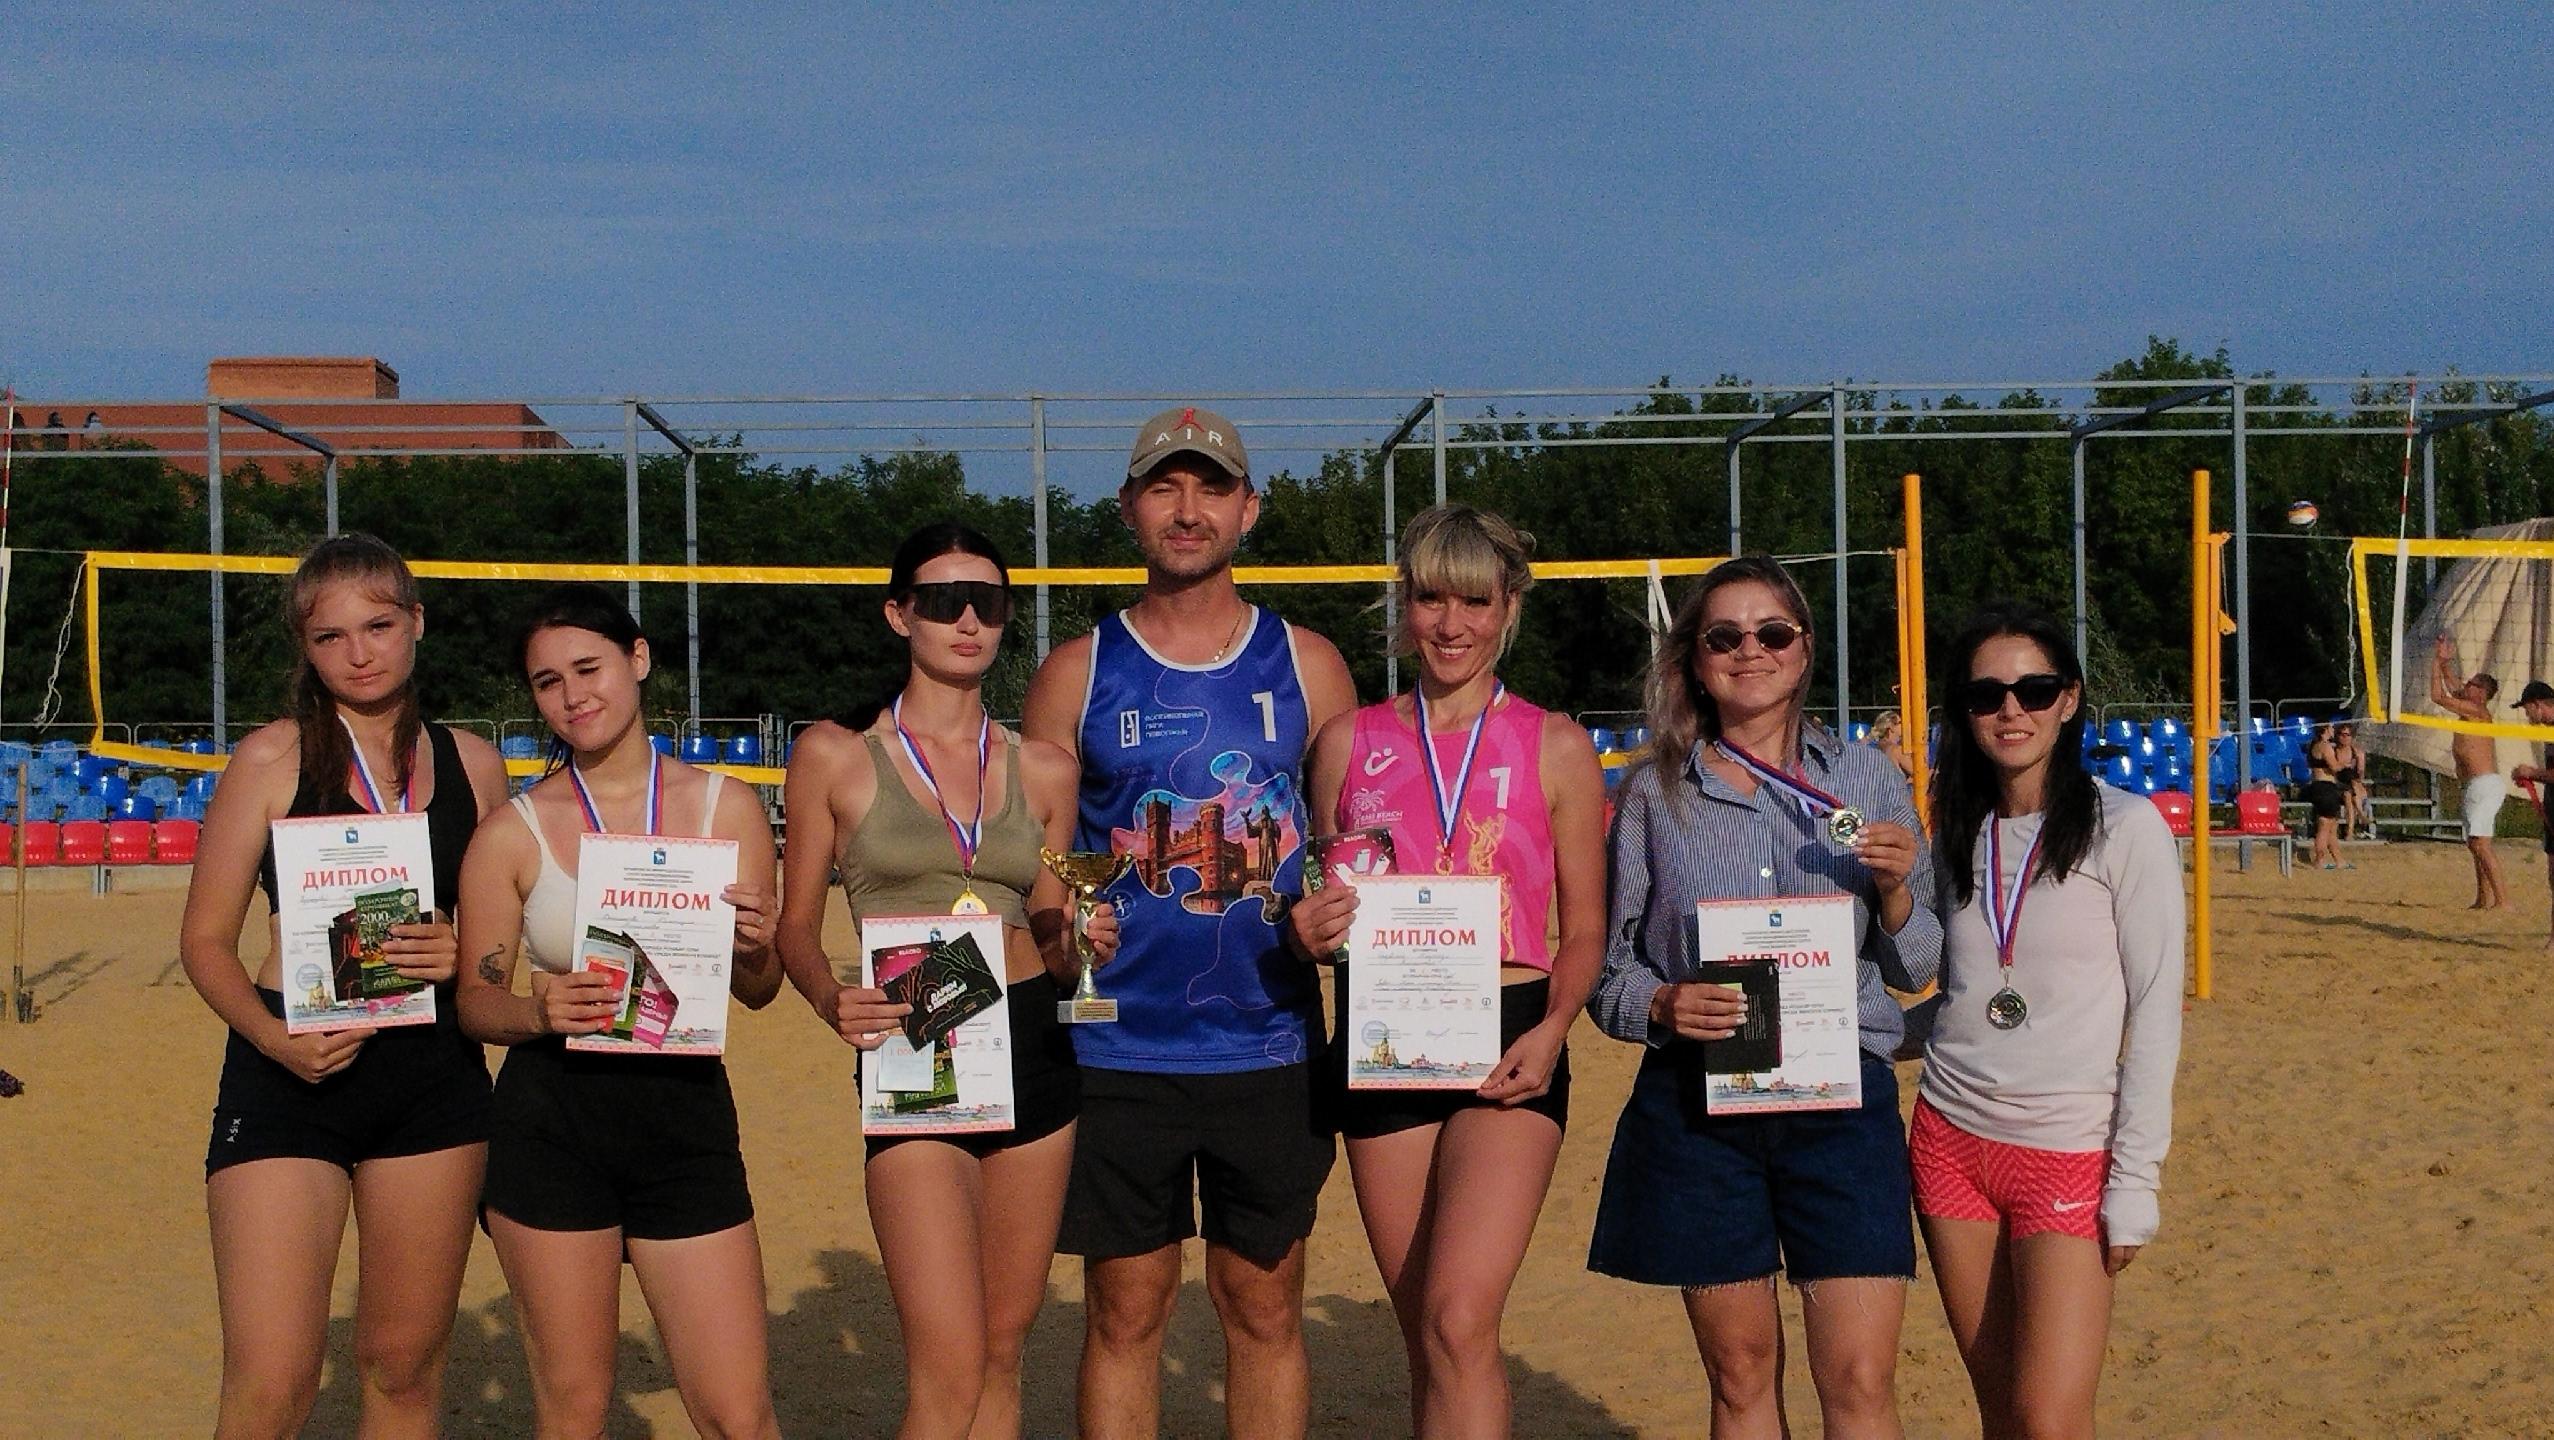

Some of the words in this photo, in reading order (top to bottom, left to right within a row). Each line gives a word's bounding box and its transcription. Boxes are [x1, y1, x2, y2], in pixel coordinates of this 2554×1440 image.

[1153, 428, 1223, 447] AIR
[1251, 690, 1277, 742] 1
[1489, 766, 1512, 809] 1
[302, 866, 409, 892] ДИПЛОМ
[600, 888, 711, 912] ДИПЛОМ
[1372, 928, 1477, 949] ДИПЛОМ
